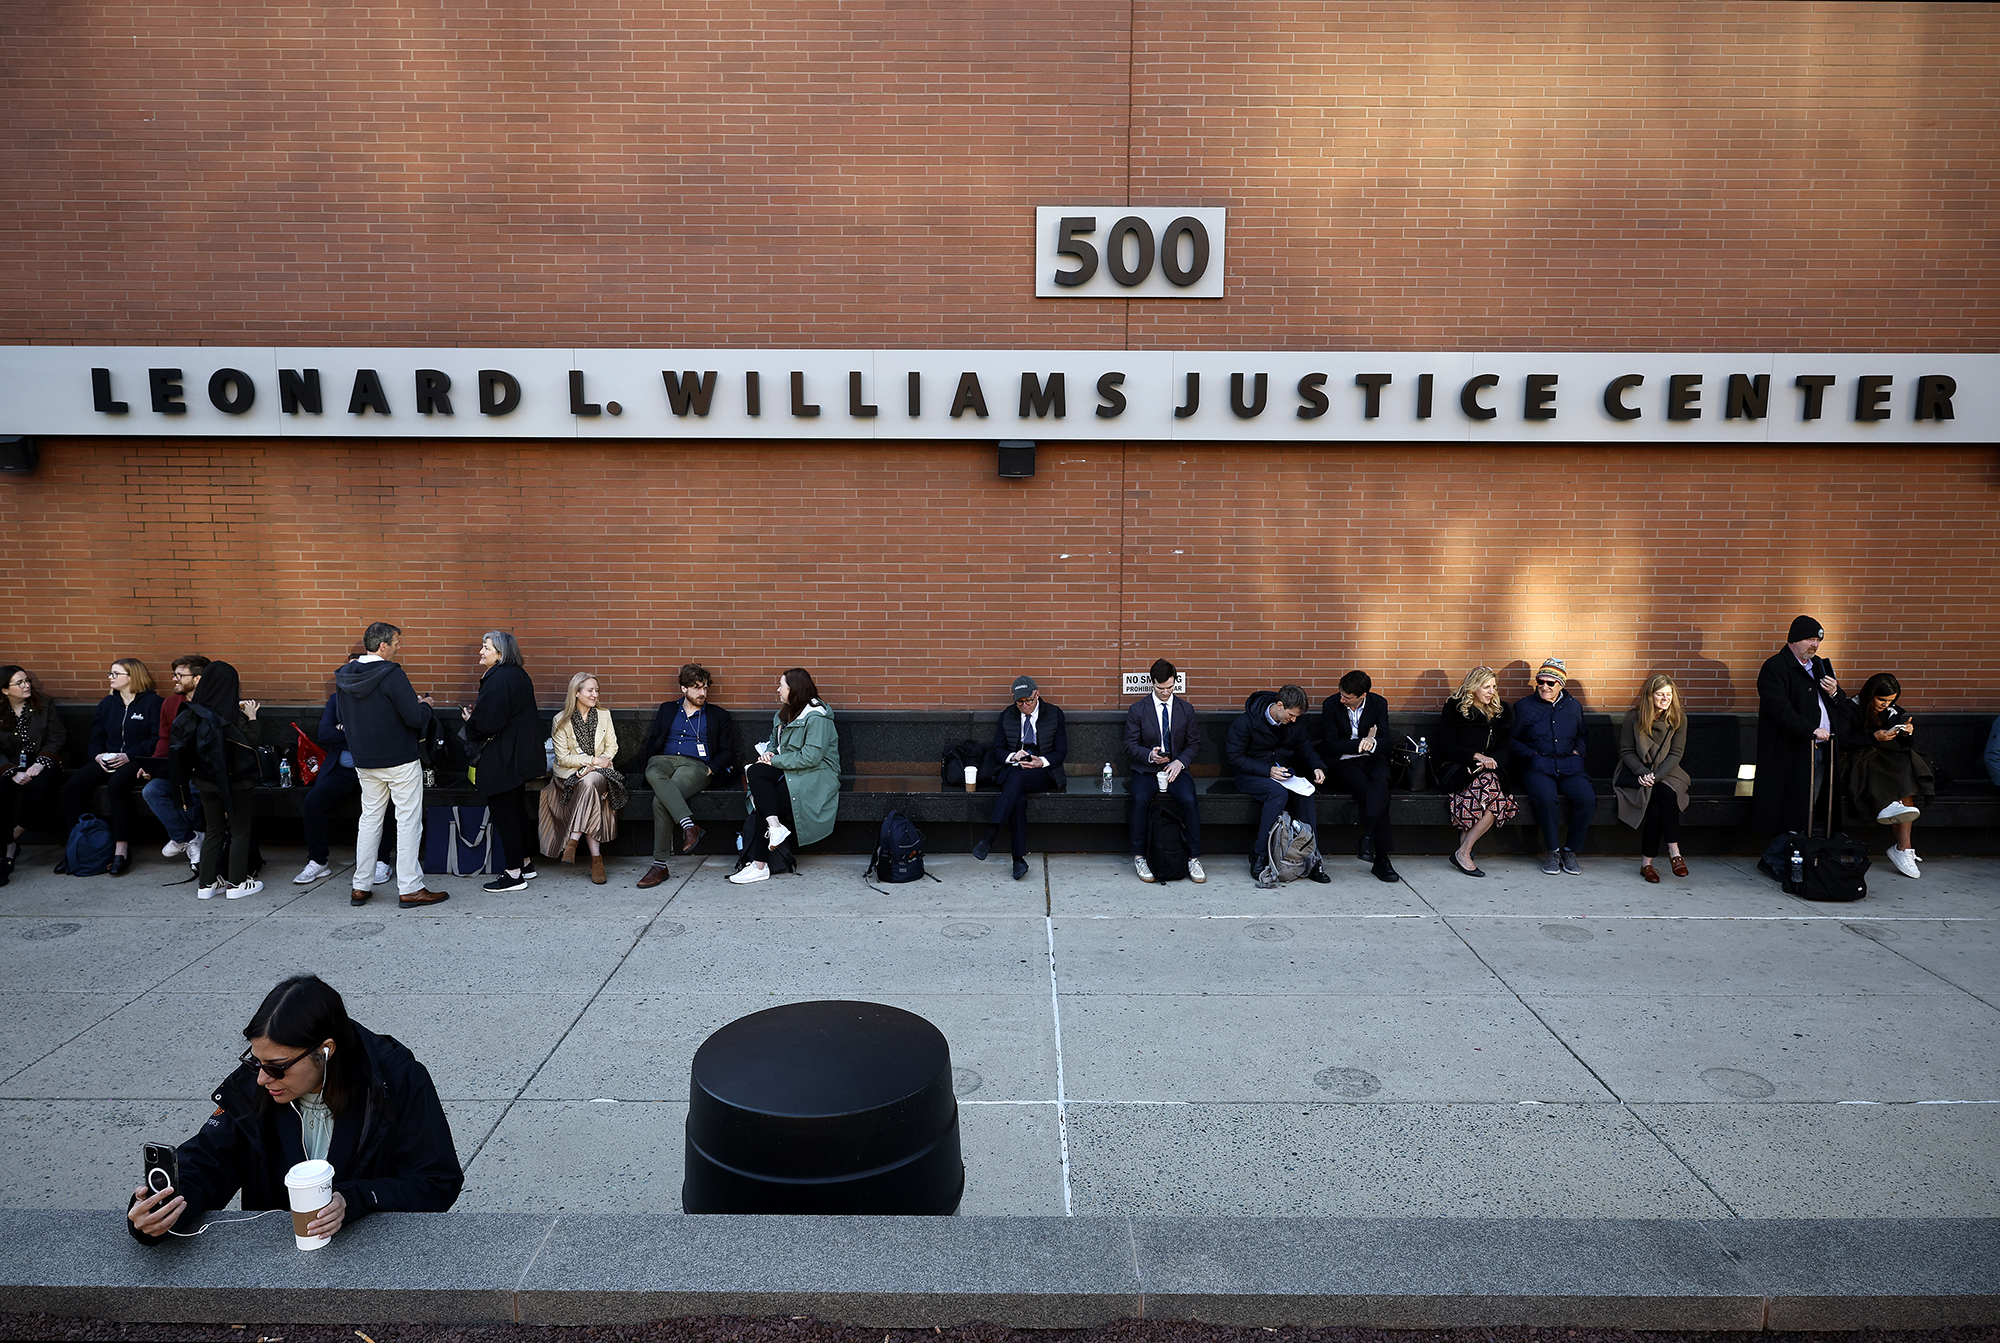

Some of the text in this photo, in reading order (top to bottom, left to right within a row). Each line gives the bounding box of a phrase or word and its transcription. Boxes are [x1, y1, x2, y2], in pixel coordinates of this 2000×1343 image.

[1054, 215, 1210, 287] 500
[91, 367, 1958, 421] LEONARD L. WILLIAMS JUSTICE CENTER
[1126, 676, 1139, 684] NO
